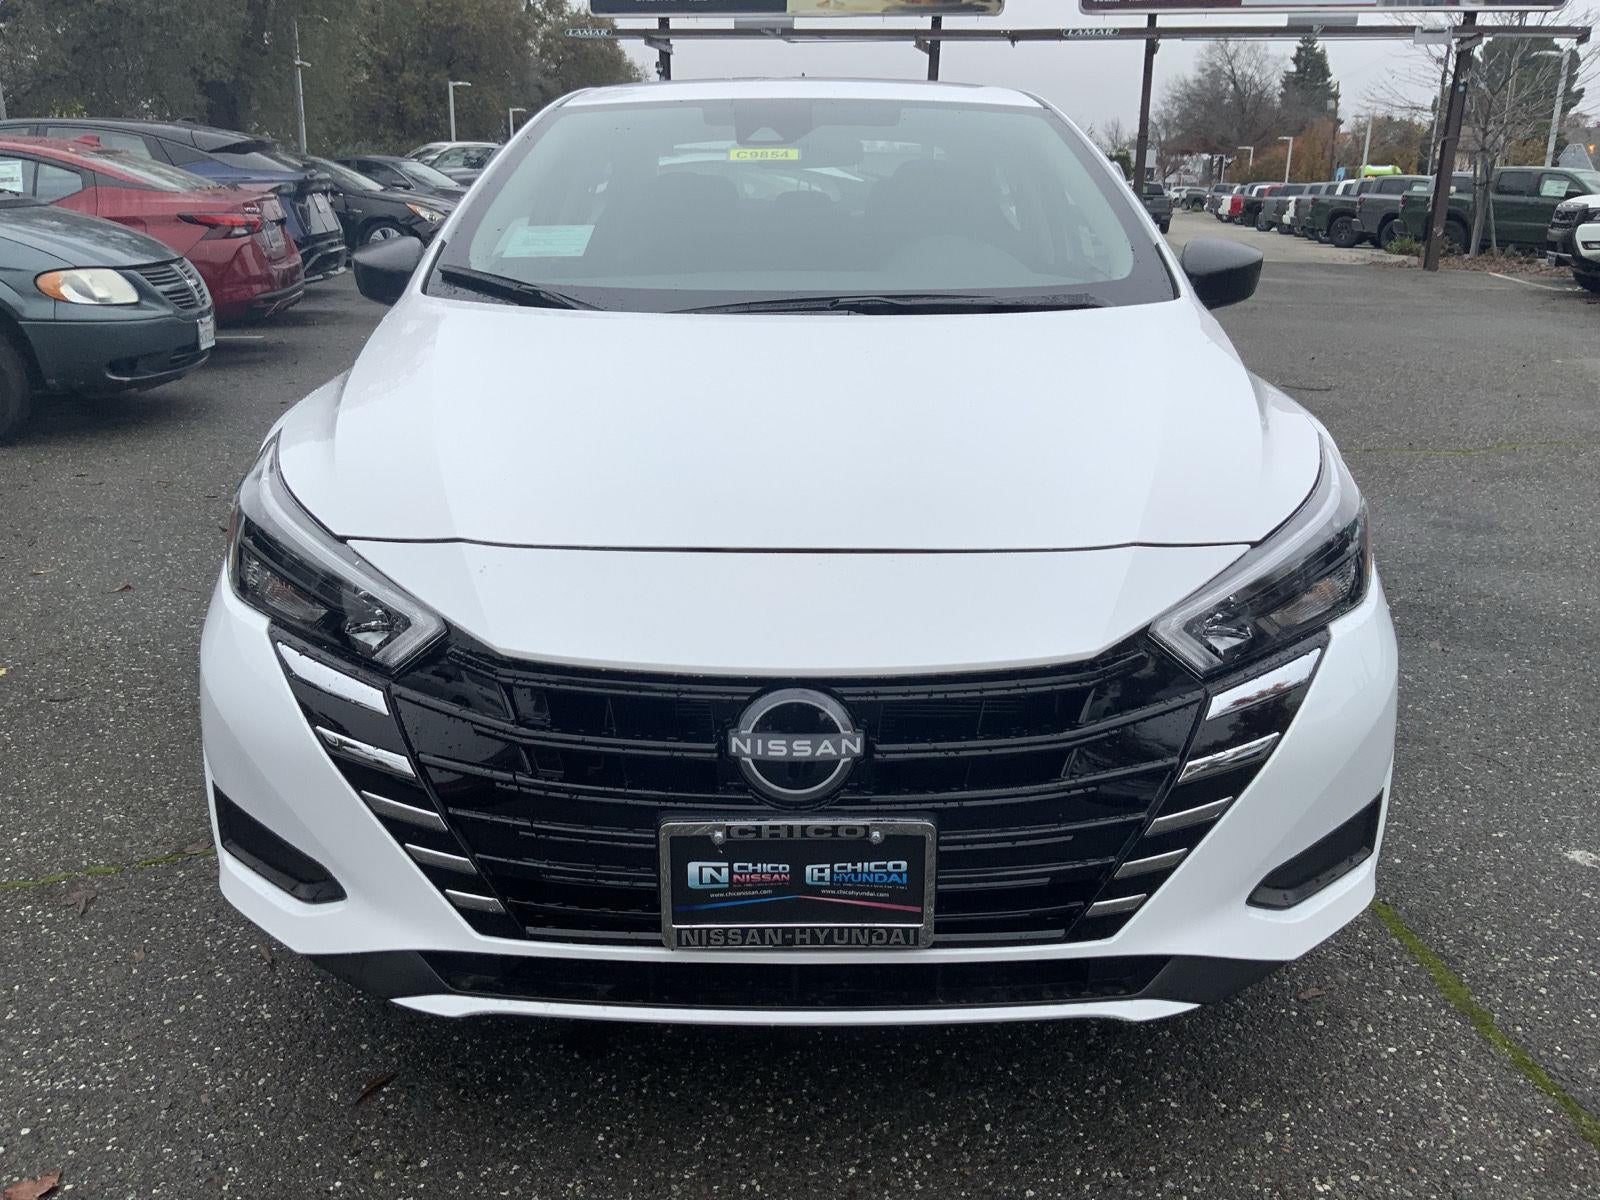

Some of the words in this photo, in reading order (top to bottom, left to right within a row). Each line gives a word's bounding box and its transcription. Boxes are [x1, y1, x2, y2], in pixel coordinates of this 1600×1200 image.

[736, 150, 789, 159] C9854
[731, 736, 861, 756] NISSAN
[729, 825, 867, 839] CHICO
[733, 862, 790, 873] CHICO
[833, 860, 908, 873] CHICO
[733, 873, 790, 882] NISSAN
[833, 873, 908, 885] HYUNDAI
[709, 889, 773, 898] www.chiconissan.com
[821, 889, 890, 898] www.chicohyundai.com
[680, 928, 916, 946] NISSAN-HYUNDAI
